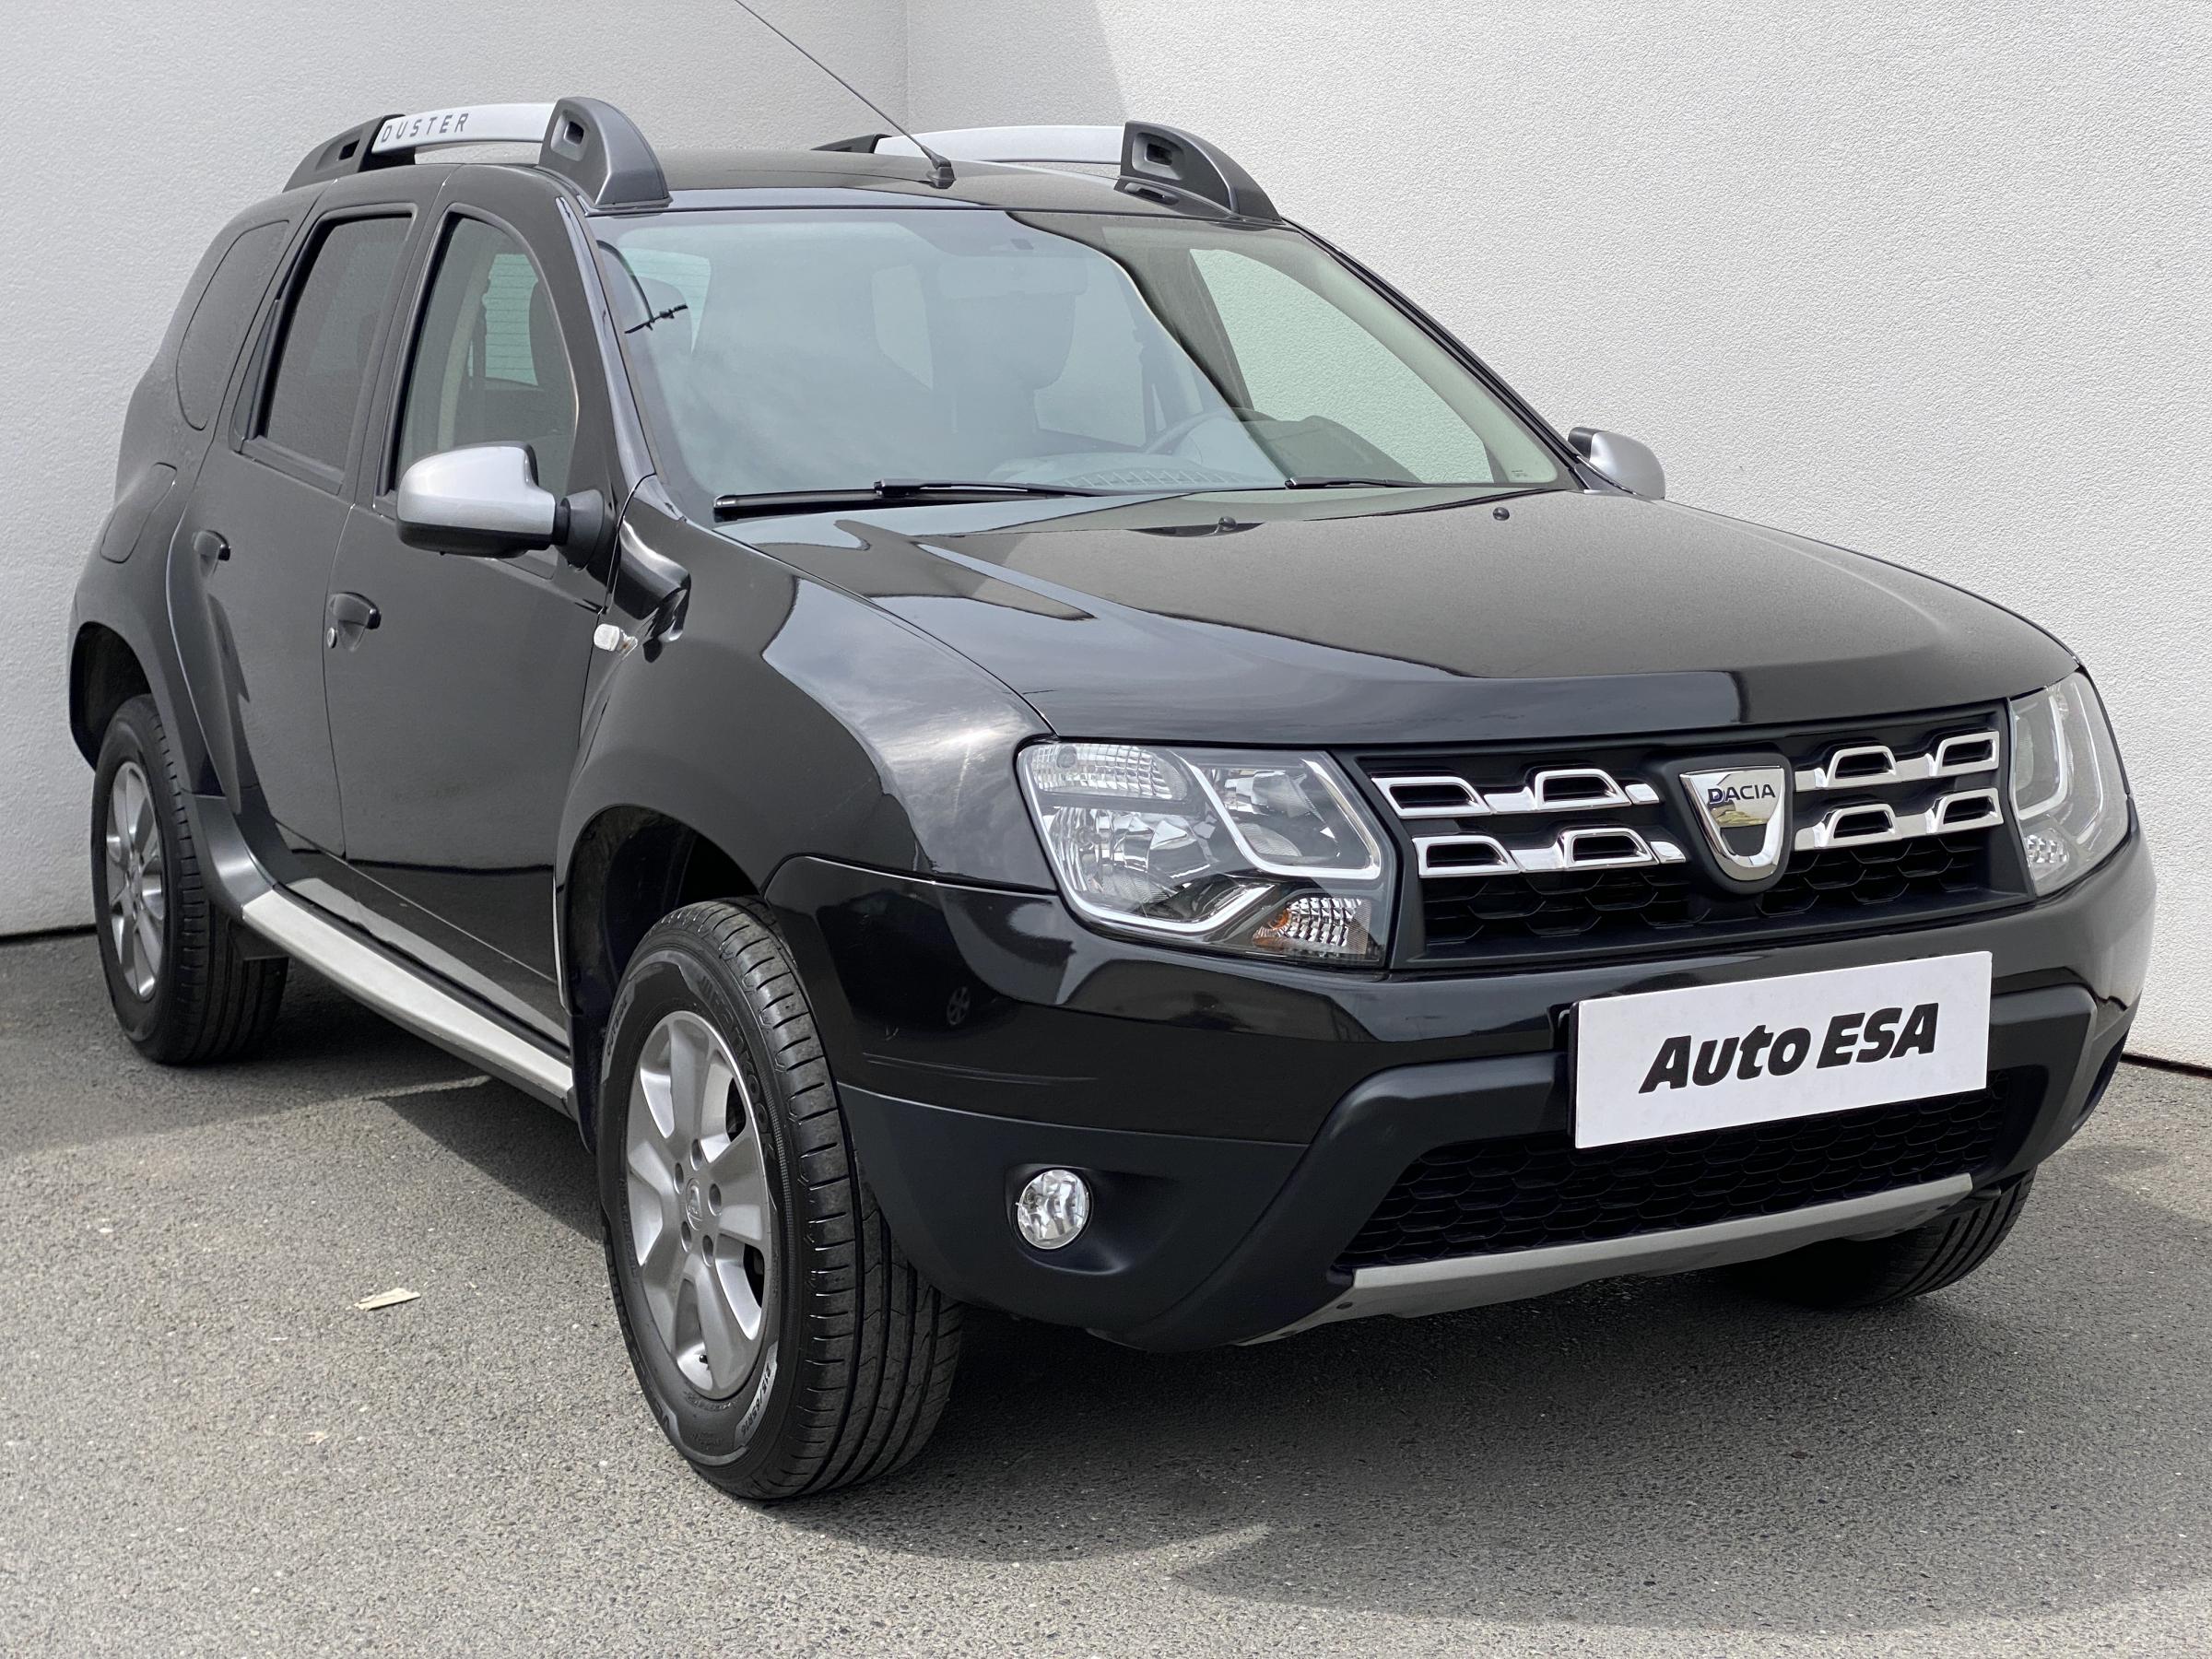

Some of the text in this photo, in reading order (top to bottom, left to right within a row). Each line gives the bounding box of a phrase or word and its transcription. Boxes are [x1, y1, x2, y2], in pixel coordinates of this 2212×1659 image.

[381, 112, 469, 143] DUSTER
[1707, 783, 1776, 804] DACIA
[1638, 1002, 1939, 1094] Auto ESA
